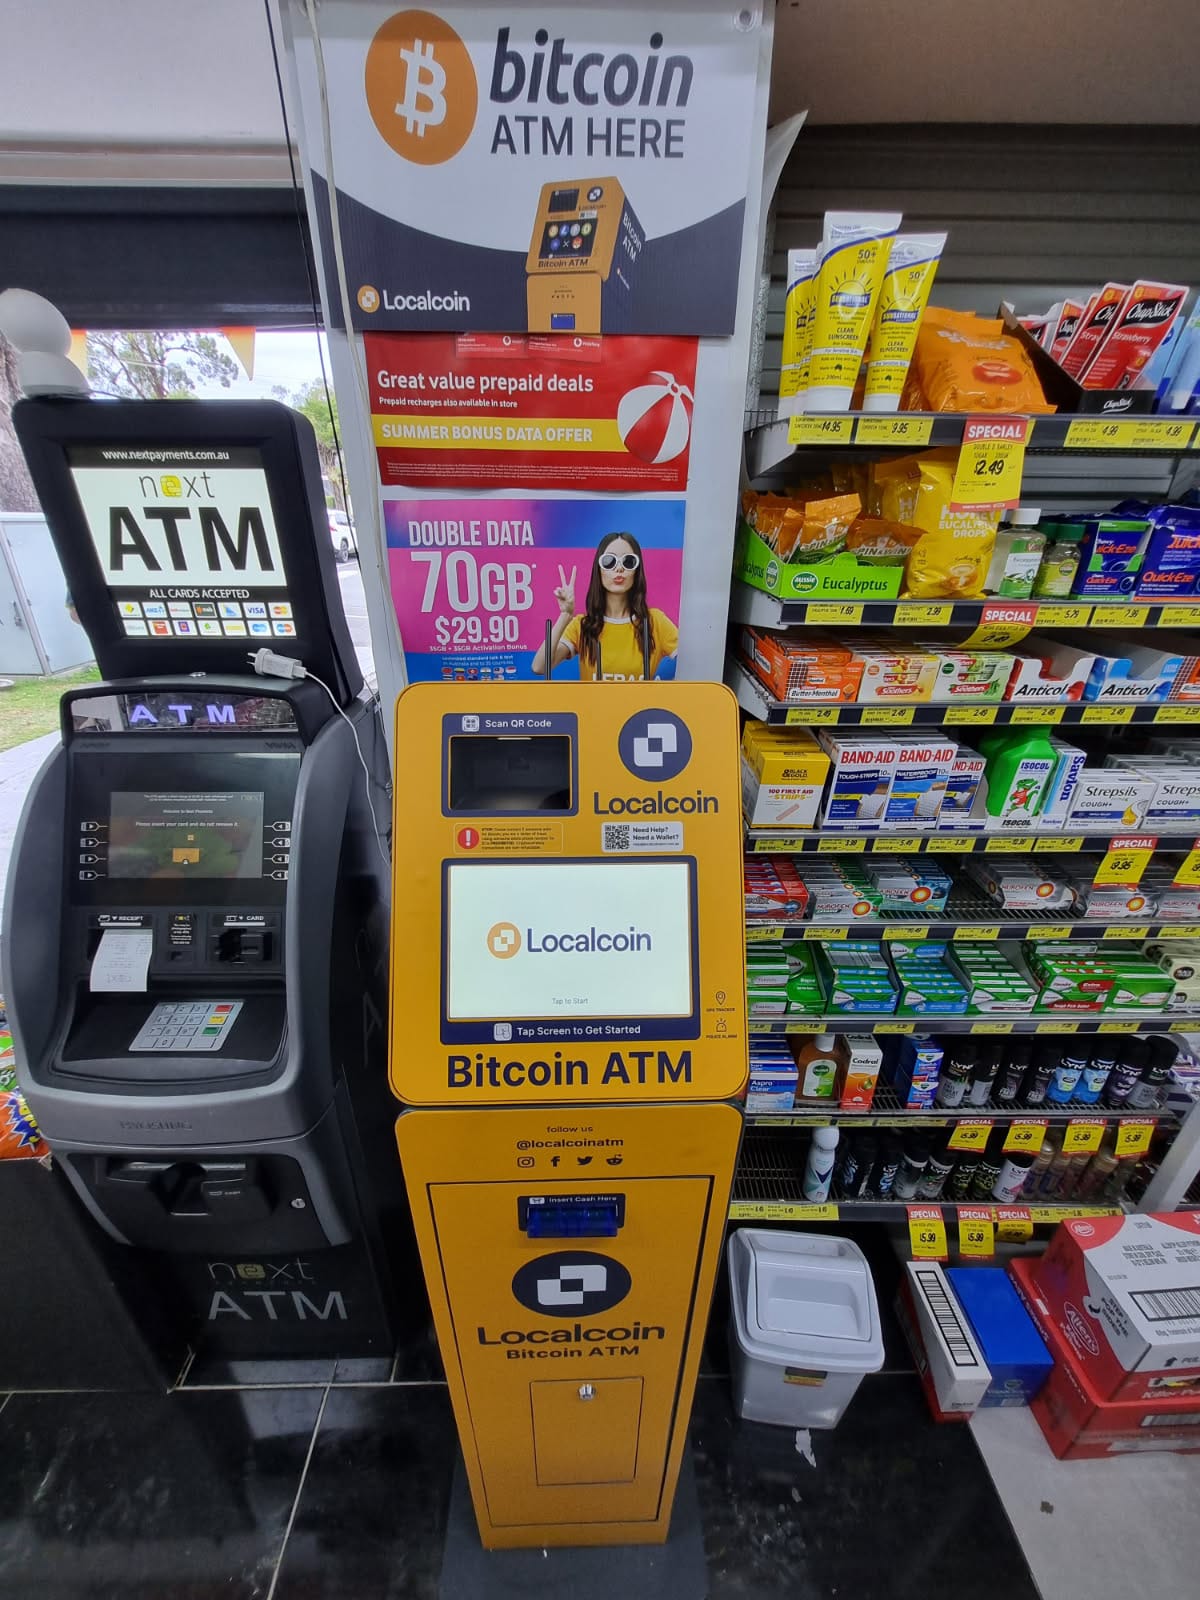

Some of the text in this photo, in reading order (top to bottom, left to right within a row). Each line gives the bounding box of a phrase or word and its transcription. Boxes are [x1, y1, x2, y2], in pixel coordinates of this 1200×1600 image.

[489, 26, 694, 107] bitcoin
[490, 115, 686, 158] ATM HERE
[858, 249, 877, 259] 50+
[538, 259, 588, 268] Bitcoin ATM
[383, 290, 470, 312] Localcoin
[1126, 300, 1176, 320] ChapStick
[1112, 331, 1152, 344] Strawberry
[377, 370, 594, 395] Great value prepaid deals
[379, 396, 518, 408] Prepaid recharges also available in store
[1103, 397, 1133, 408] ChapStick
[382, 424, 592, 442] SUMMER BONUS DATA OFFER
[821, 420, 843, 433] 14.95
[891, 422, 909, 434] 9.95
[968, 425, 1022, 438] SPECIAL
[102, 450, 229, 461] www.nextpayments.com.au
[974, 459, 1005, 476] $2.49
[139, 471, 215, 498] next
[109, 506, 275, 571] ATM
[408, 520, 534, 546] DOUBLE DATA
[953, 529, 987, 538] DROPS
[823, 577, 888, 591] Eucalyptus
[150, 589, 250, 599] ALL CARDS ACCEPTED
[985, 610, 1031, 621] SPECIAL
[435, 615, 518, 645] $29.90
[954, 685, 985, 693] Soothers
[1015, 684, 1066, 696] Anticol
[1102, 684, 1153, 696] Anticol
[485, 718, 552, 729] Scan QR Code
[840, 751, 895, 764] BAND-AID
[898, 749, 954, 762] BAND-AID
[952, 761, 984, 772] ND-AID
[1021, 762, 1050, 770] ISOCOL
[839, 772, 879, 780] TOUGH-STRIPS
[896, 769, 937, 777] WATERPROOF
[1060, 756, 1085, 801] Savlon
[1085, 786, 1138, 799] Strepsils
[1161, 784, 1200, 797] Streps
[594, 790, 719, 815] Localcoin
[650, 826, 669, 834] Help?
[1113, 840, 1153, 848] SPECIAL
[527, 927, 652, 953] Localcoin
[552, 997, 589, 1006] Tap to Start
[517, 1024, 641, 1037] Tap Screen to Get Started
[852, 1058, 879, 1066] Codral
[1061, 1059, 1086, 1069] LYN
[1091, 1060, 1113, 1070] LYN
[447, 1050, 693, 1088] Bitcoin ATM
[546, 1125, 578, 1133] follow
[516, 1137, 624, 1150] @localcoinatm
[910, 1211, 940, 1219] SPECIAL
[960, 1211, 990, 1220] SPECIAL
[999, 1211, 1029, 1219] SPECIAL
[208, 1258, 313, 1280] next
[208, 1291, 348, 1320] ATM
[1109, 1297, 1123, 1318] STEP
[1101, 1297, 1129, 1338] POP THE
[1102, 1307, 1121, 1337] SIDES
[477, 1322, 665, 1346] Localcoin
[506, 1346, 640, 1360] Bitcoin ATM
